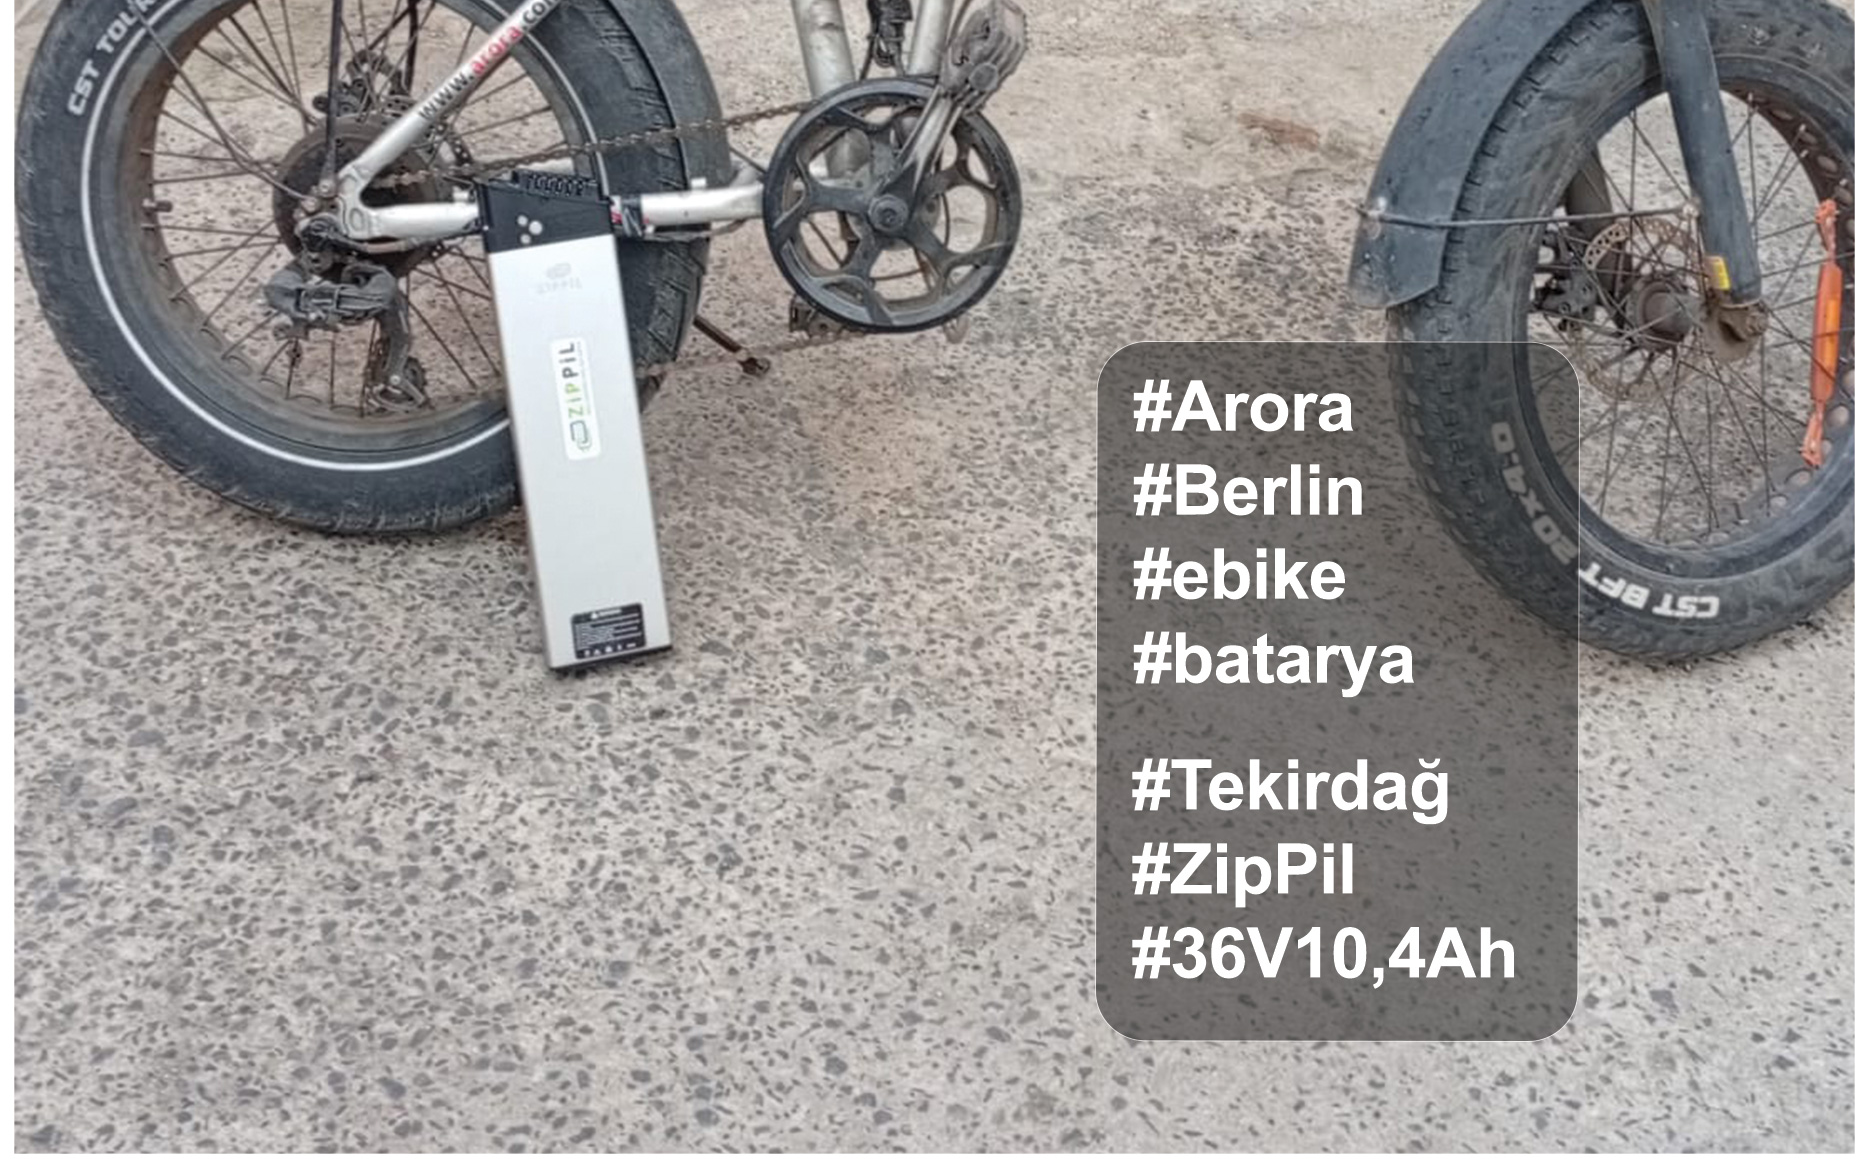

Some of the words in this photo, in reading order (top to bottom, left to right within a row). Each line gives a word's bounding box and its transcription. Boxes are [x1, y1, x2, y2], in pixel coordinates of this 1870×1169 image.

[67, 59, 100, 115] CST
[1577, 562, 1650, 609] BFT
[1652, 593, 1720, 618] CST
